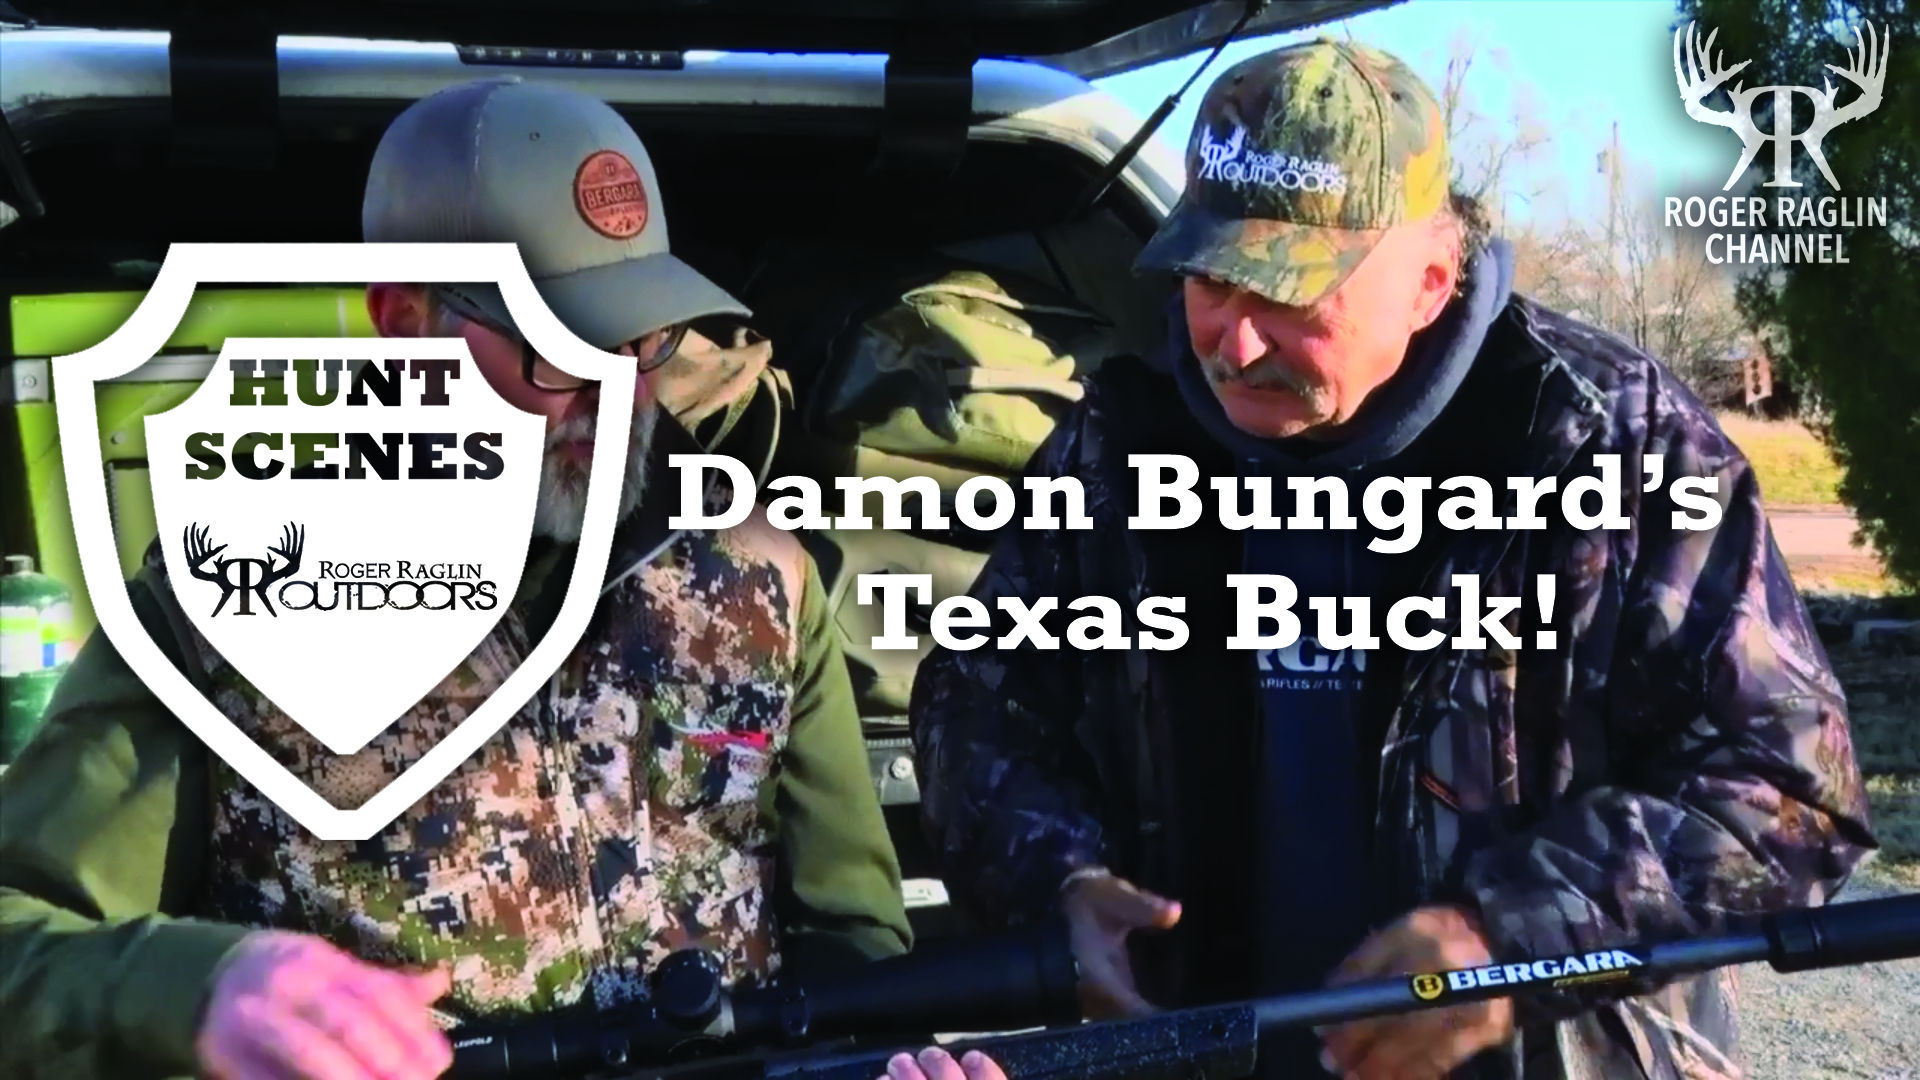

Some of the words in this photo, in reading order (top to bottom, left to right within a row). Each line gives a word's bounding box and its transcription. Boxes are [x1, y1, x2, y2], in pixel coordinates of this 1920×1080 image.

[1245, 151, 1287, 168] ROGER
[1223, 161, 1348, 193] OUTDOORS
[1266, 678, 1310, 690] RIFLES
[1447, 950, 1643, 991] BERGARA
